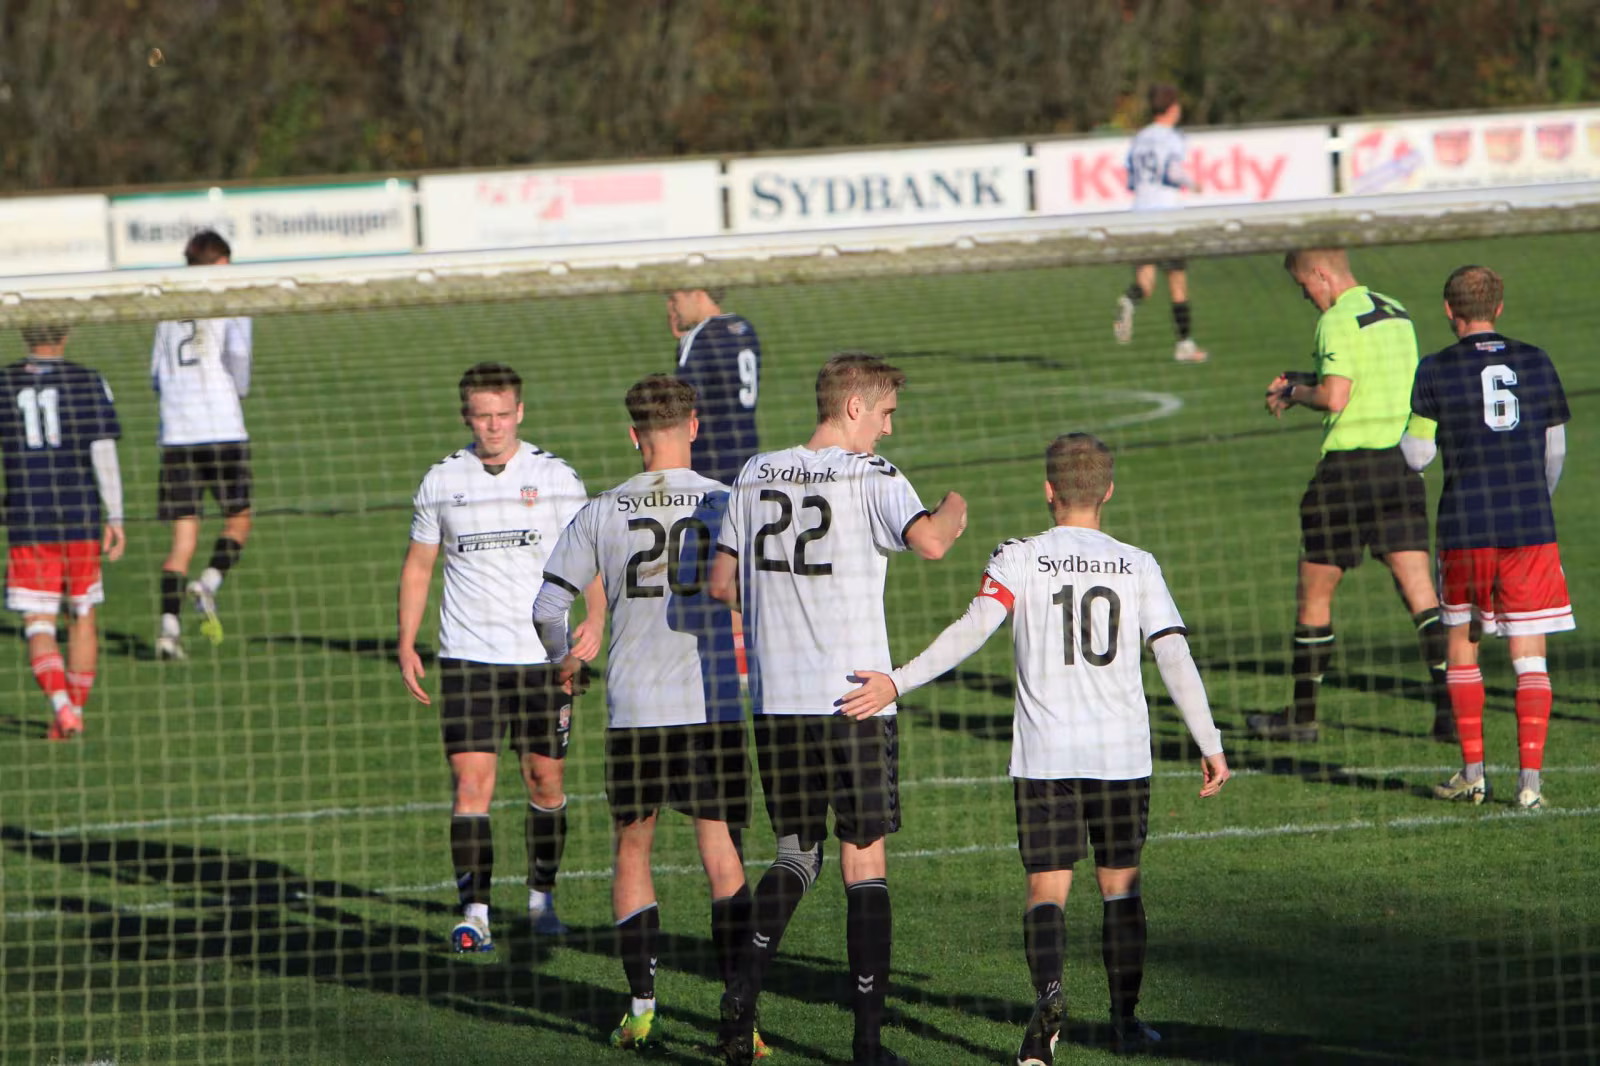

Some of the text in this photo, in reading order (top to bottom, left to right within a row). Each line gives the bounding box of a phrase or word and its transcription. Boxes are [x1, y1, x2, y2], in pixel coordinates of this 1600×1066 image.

[751, 166, 1006, 219] SYDBANK
[737, 348, 758, 408] 9
[1480, 363, 1520, 431] 6
[17, 387, 61, 448] 11
[617, 491, 716, 513] Sydbank
[758, 463, 837, 484] Sydbank
[626, 516, 710, 599] 20
[754, 489, 833, 576] 22
[1037, 555, 1133, 577] Sydbank
[1052, 584, 1121, 667] 10
